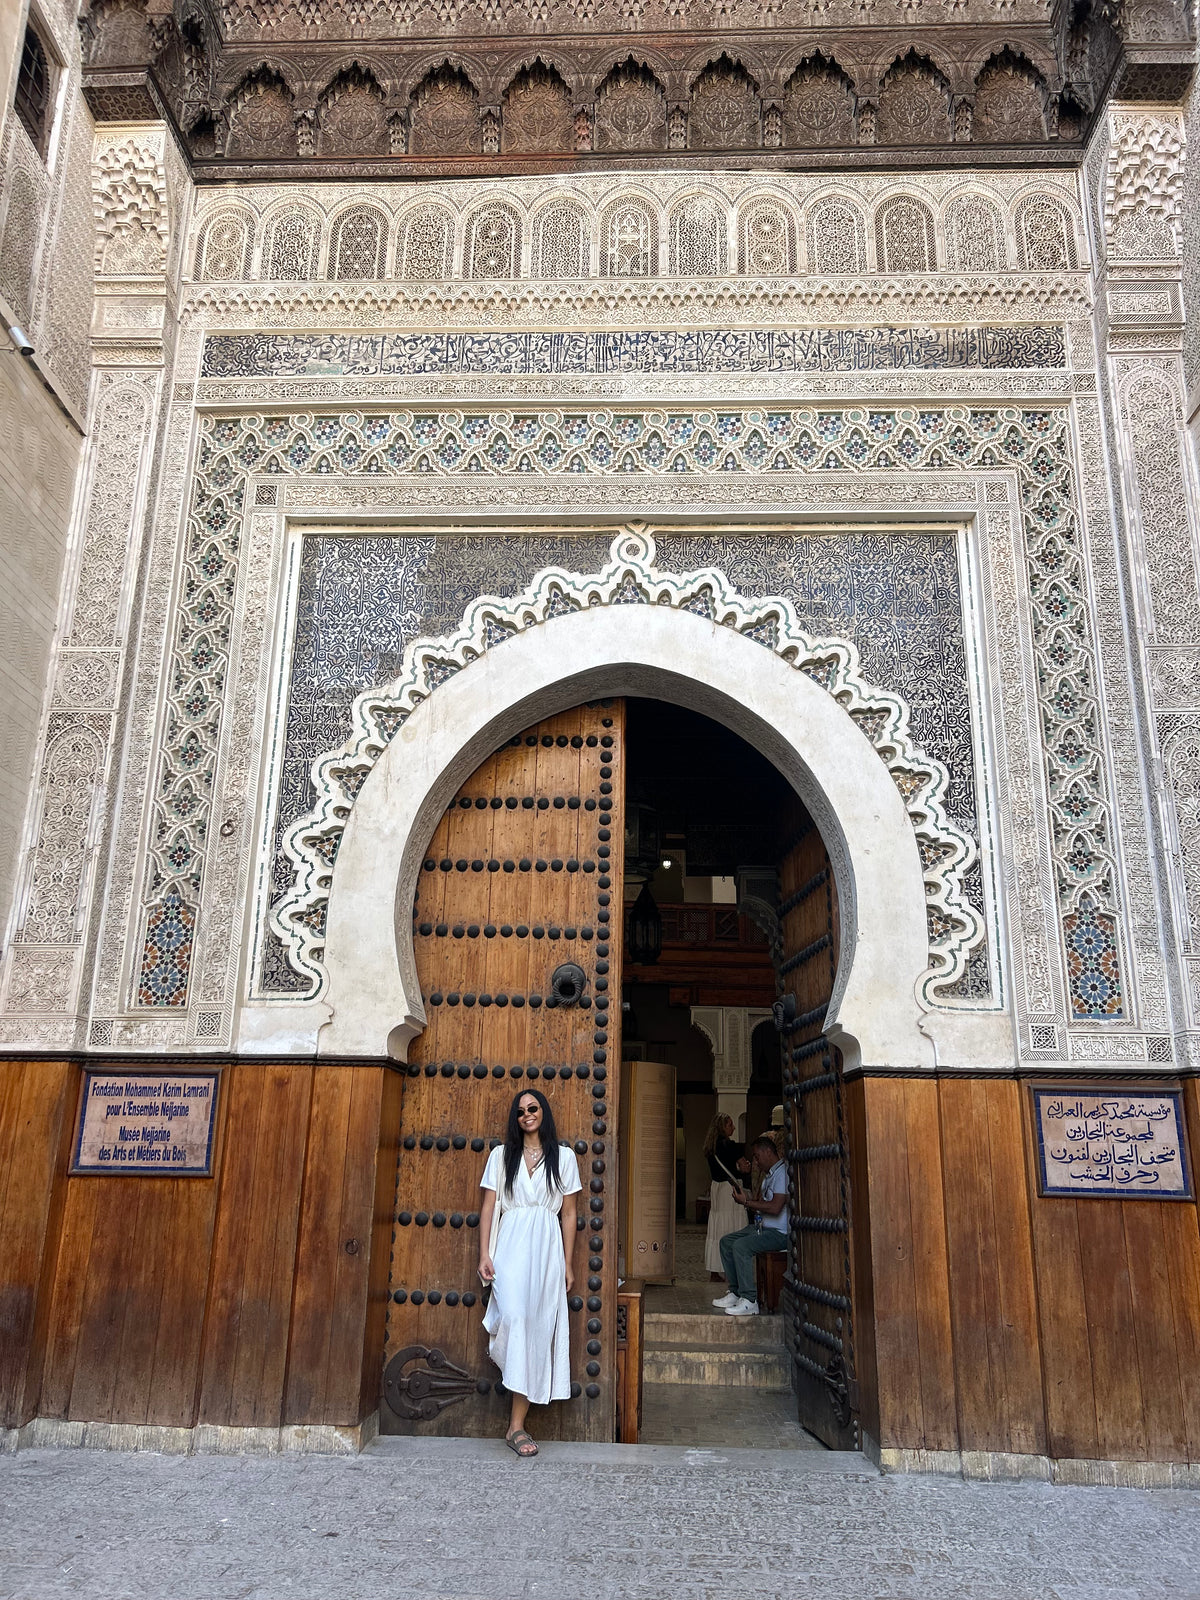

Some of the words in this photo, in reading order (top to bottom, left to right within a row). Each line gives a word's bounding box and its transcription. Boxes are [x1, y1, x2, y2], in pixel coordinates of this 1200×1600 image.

[92, 1082, 123, 1096] Fondation
[125, 1083, 161, 1097] Mohammed
[162, 1083, 181, 1097] Karim
[183, 1083, 209, 1097] Lamrani
[106, 1104, 122, 1119] pour
[123, 1101, 159, 1116] L'Ensemble
[161, 1102, 189, 1120] Nejjarine
[1047, 1101, 1082, 1119] العمراني
[1084, 1102, 1119, 1119] كريم
[1109, 1104, 1135, 1120] محمد
[1135, 1104, 1171, 1120] مؤسسة
[119, 1126, 140, 1141] Musée
[141, 1127, 170, 1145] Nejjarine
[1066, 1121, 1105, 1140] النجارين
[1106, 1122, 1154, 1143] لمجموعة
[99, 1145, 111, 1160] des
[112, 1146, 126, 1160] Arts
[128, 1147, 135, 1160] et
[137, 1145, 161, 1161] Métiers
[162, 1146, 171, 1160] du
[172, 1146, 186, 1161] Bois
[1051, 1142, 1089, 1163] لفنون
[1092, 1144, 1138, 1165] النجارين
[1140, 1147, 1175, 1165] متحف
[1070, 1165, 1113, 1183] الخشب
[1115, 1168, 1159, 1184] وحرف
